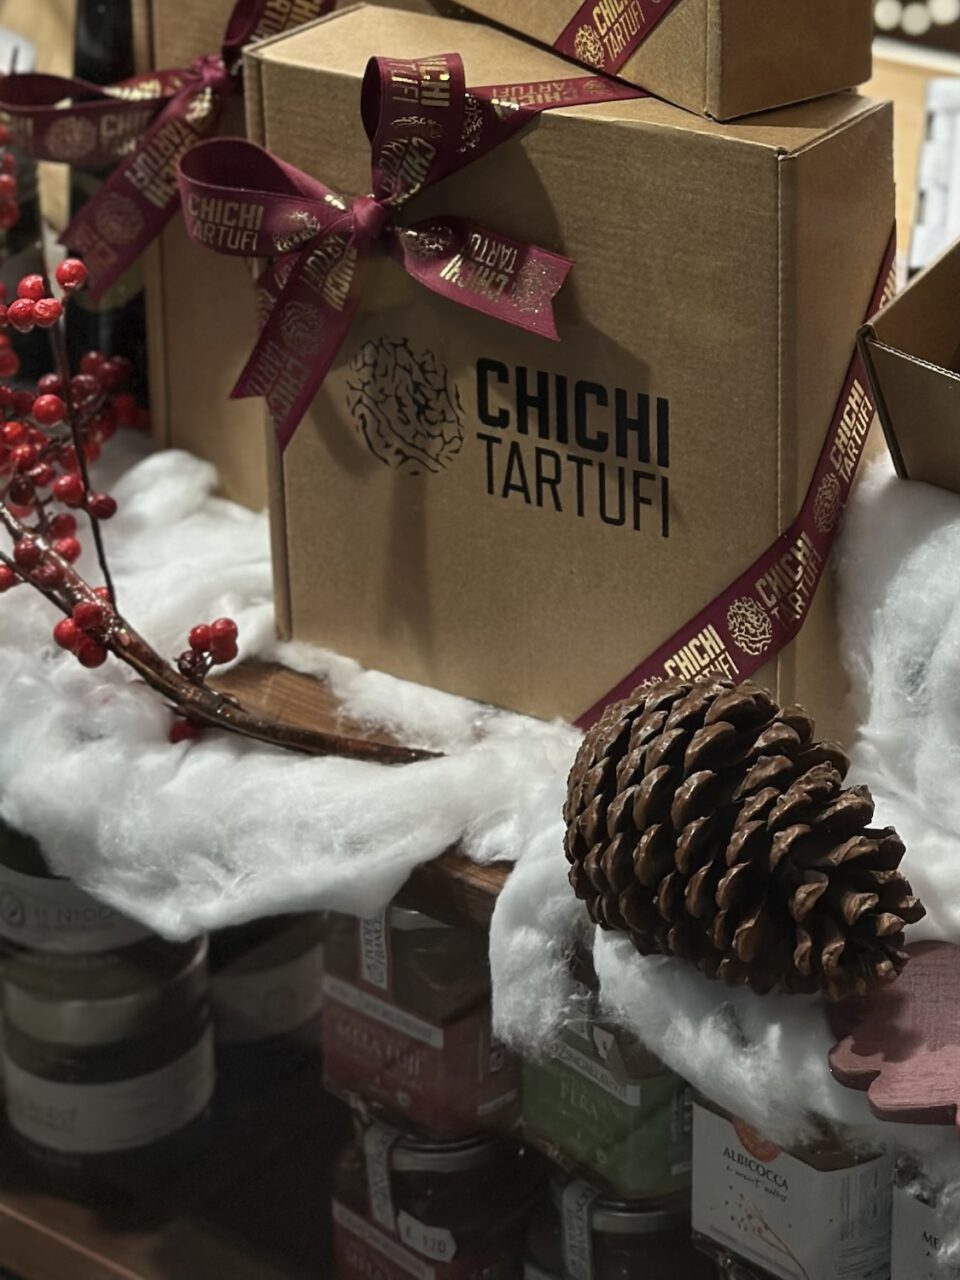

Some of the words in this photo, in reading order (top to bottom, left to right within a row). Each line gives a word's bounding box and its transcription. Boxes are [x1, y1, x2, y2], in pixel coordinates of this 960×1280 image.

[188, 194, 265, 231] CHICHI
[192, 223, 259, 252] ARTUFI
[476, 357, 670, 469] CHICHI
[829, 378, 865, 470] CHICHI
[836, 395, 873, 483] TARTUFI
[476, 431, 670, 539] TARTUFI
[754, 530, 814, 610] CHICHI
[663, 623, 726, 681] CHICHI
[723, 1146, 789, 1191] ALBICOCCA
